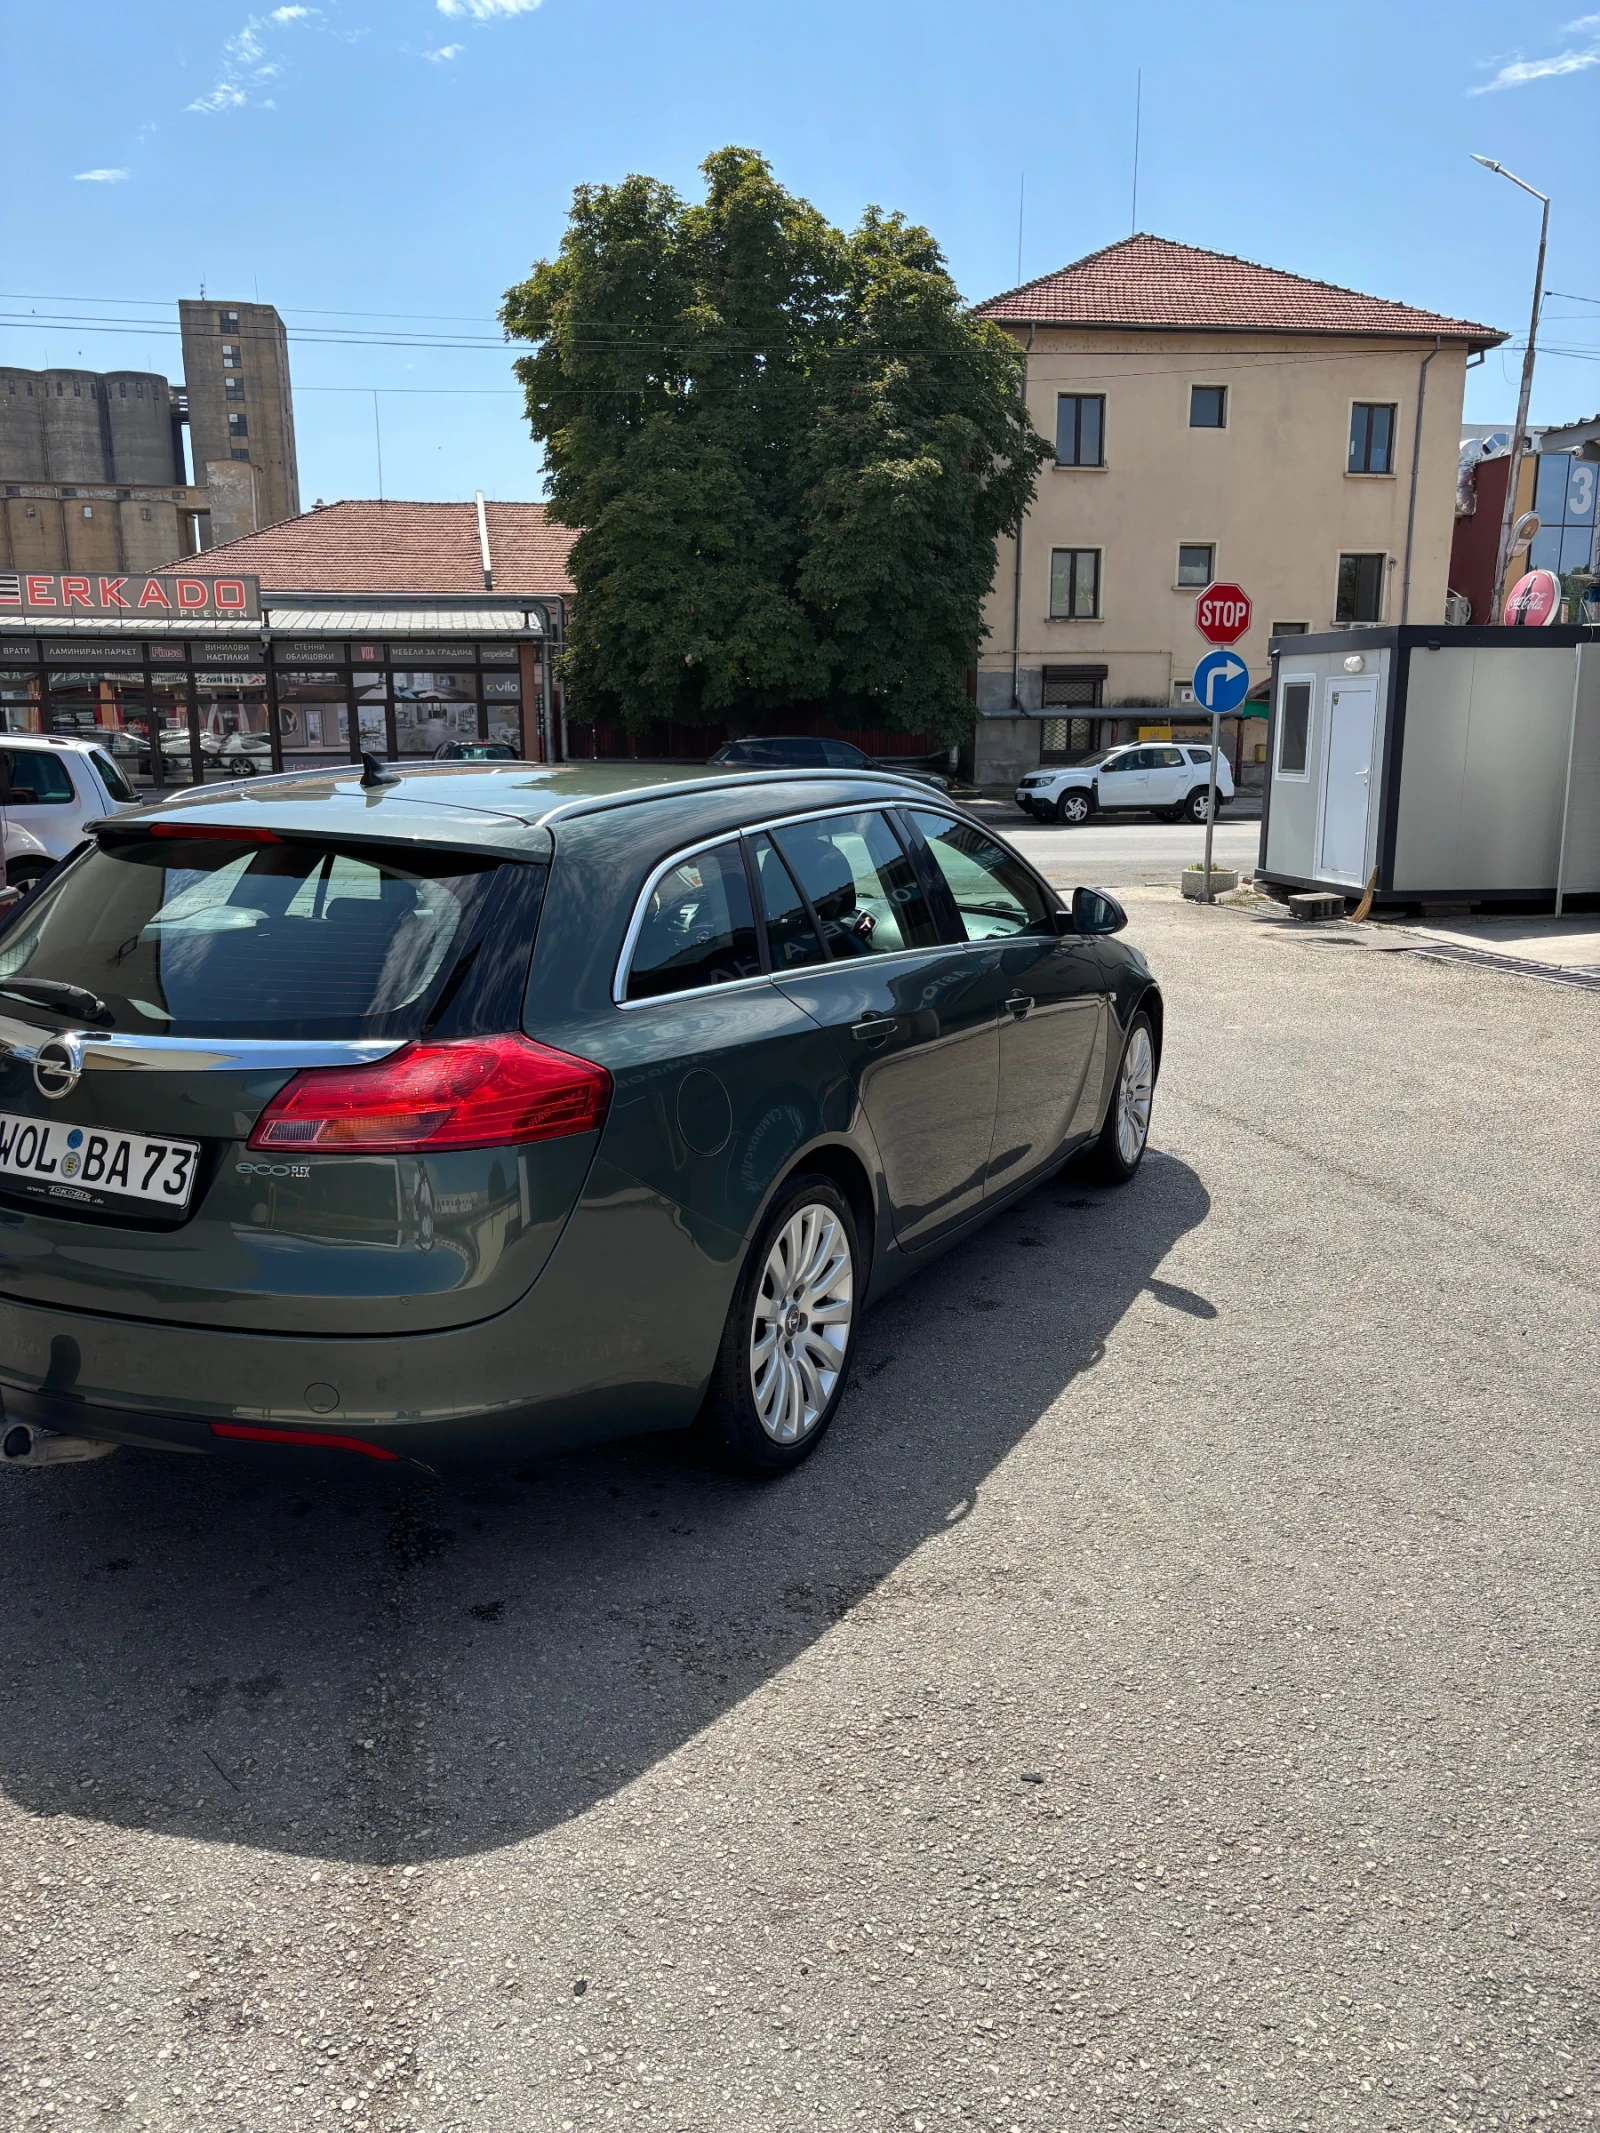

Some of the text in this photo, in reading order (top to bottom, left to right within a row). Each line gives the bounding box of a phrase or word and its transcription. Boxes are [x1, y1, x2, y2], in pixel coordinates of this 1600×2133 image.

[1569, 466, 1593, 515] 3
[26, 574, 246, 610] ERKADO
[180, 609, 248, 618] PLEVEN
[1201, 600, 1247, 627] STOP
[3, 647, 31, 655] ВРАТИ
[204, 643, 250, 651] ВИНИЛОВИ
[293, 643, 325, 651] СТЕННИ
[49, 648, 137, 656] ЛАМИНИРАН ПАРКЕТ
[151, 646, 183, 658] Finsa
[360, 646, 375, 660] VOX
[391, 648, 473, 656] МЕБЕЛИ ЗА ГРАДИНА
[206, 653, 250, 661] НАСТИЛКИ
[285, 653, 334, 661] ОБЛИЦОВКИ
[495, 681, 519, 692] vilo
[0, 1121, 192, 1195] WOL BA 73
